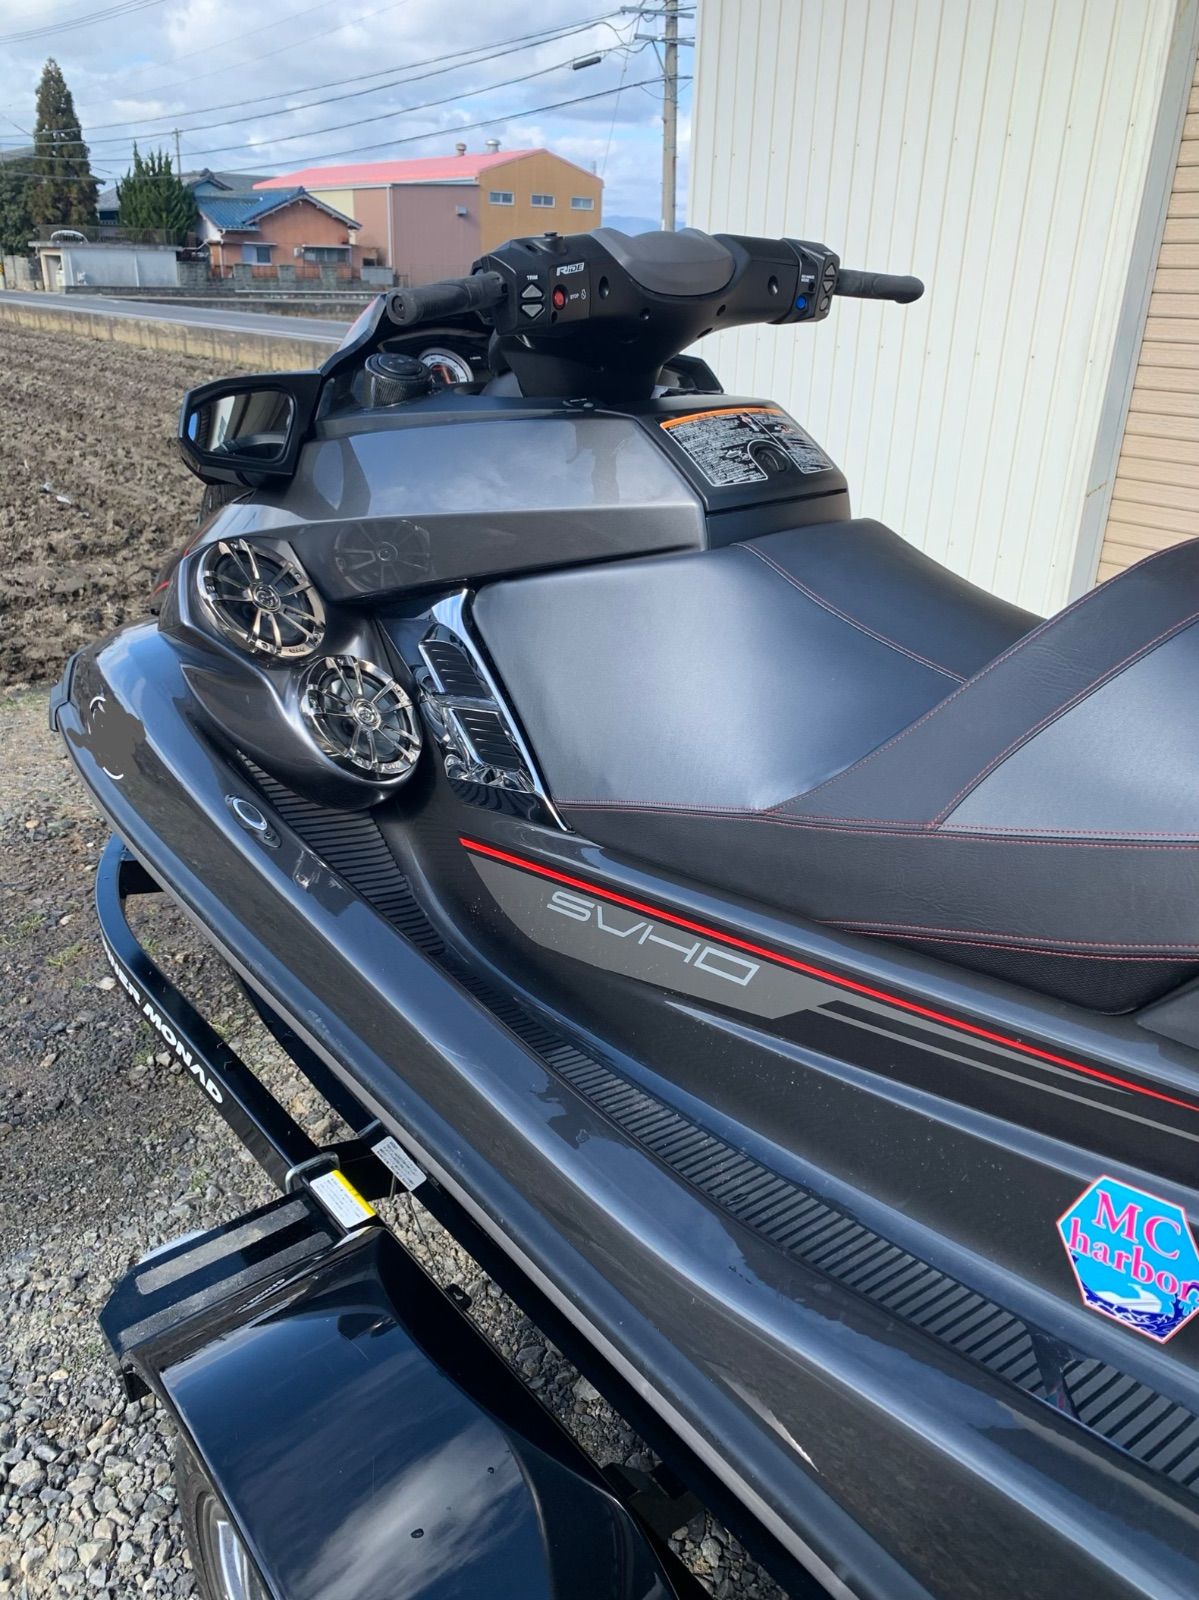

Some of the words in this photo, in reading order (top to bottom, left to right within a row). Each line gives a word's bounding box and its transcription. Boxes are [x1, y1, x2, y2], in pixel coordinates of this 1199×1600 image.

[546, 890, 761, 987] SVHO
[142, 1003, 224, 1104] MONAD
[1069, 1217, 1199, 1303] harbor
[1092, 1188, 1182, 1260] MC
